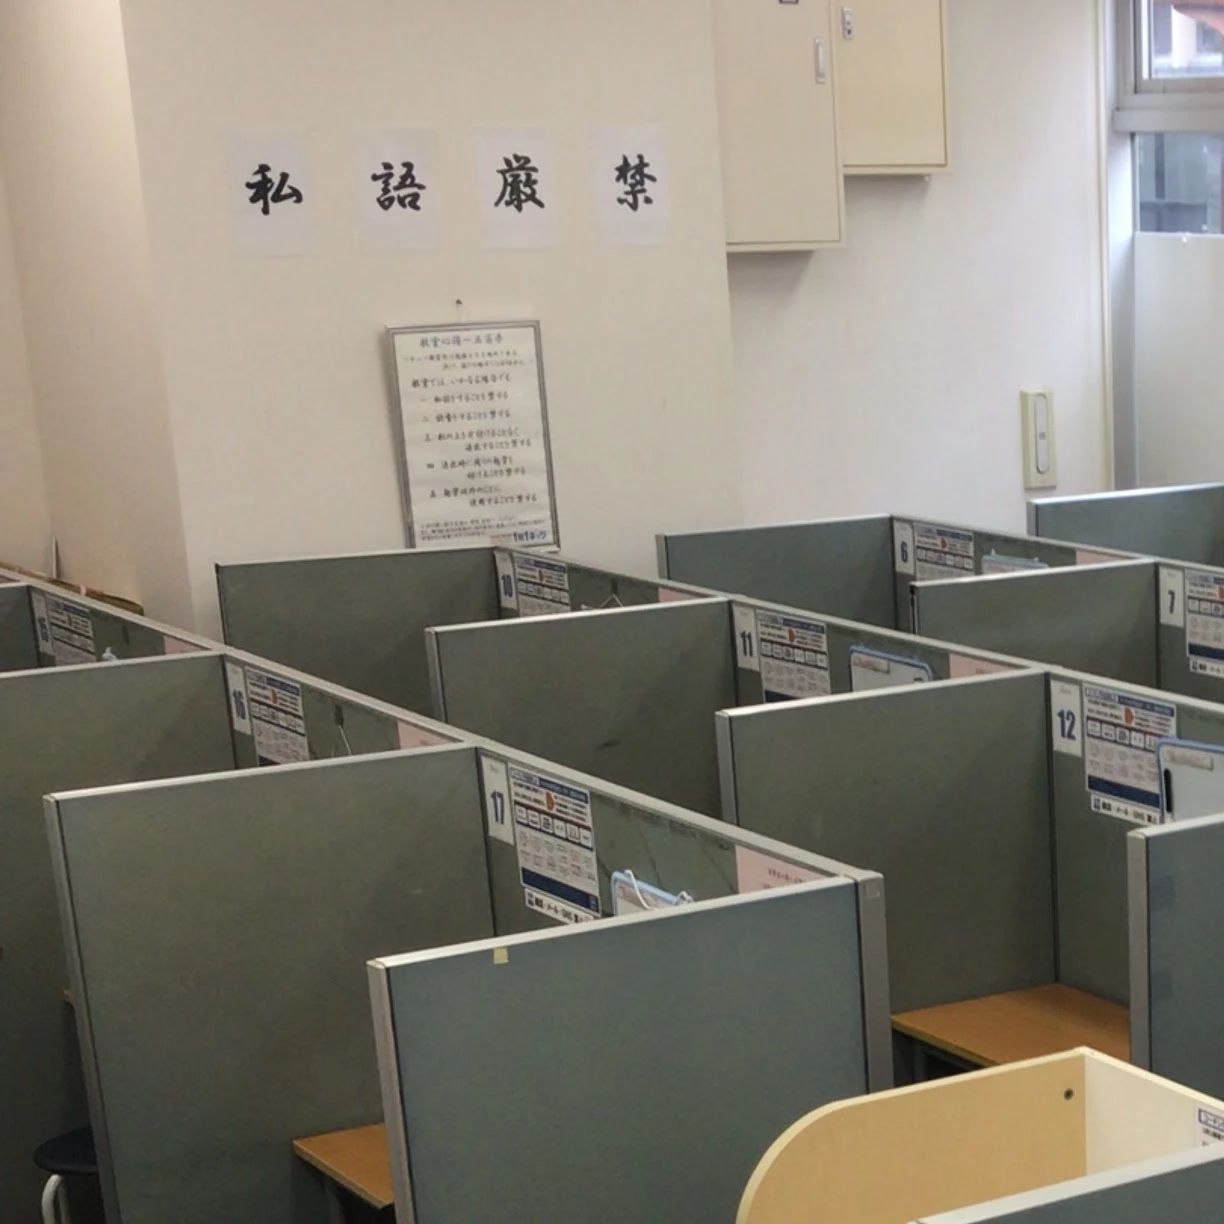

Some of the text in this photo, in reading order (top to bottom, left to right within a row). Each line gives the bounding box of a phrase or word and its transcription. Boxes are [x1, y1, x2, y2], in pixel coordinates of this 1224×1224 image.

[245, 153, 657, 216] 私語厳禁
[901, 541, 909, 564] 6
[1169, 589, 1176, 614] 7
[739, 631, 754, 658] 11
[1056, 709, 1077, 740] 12
[490, 790, 506, 827] 17
